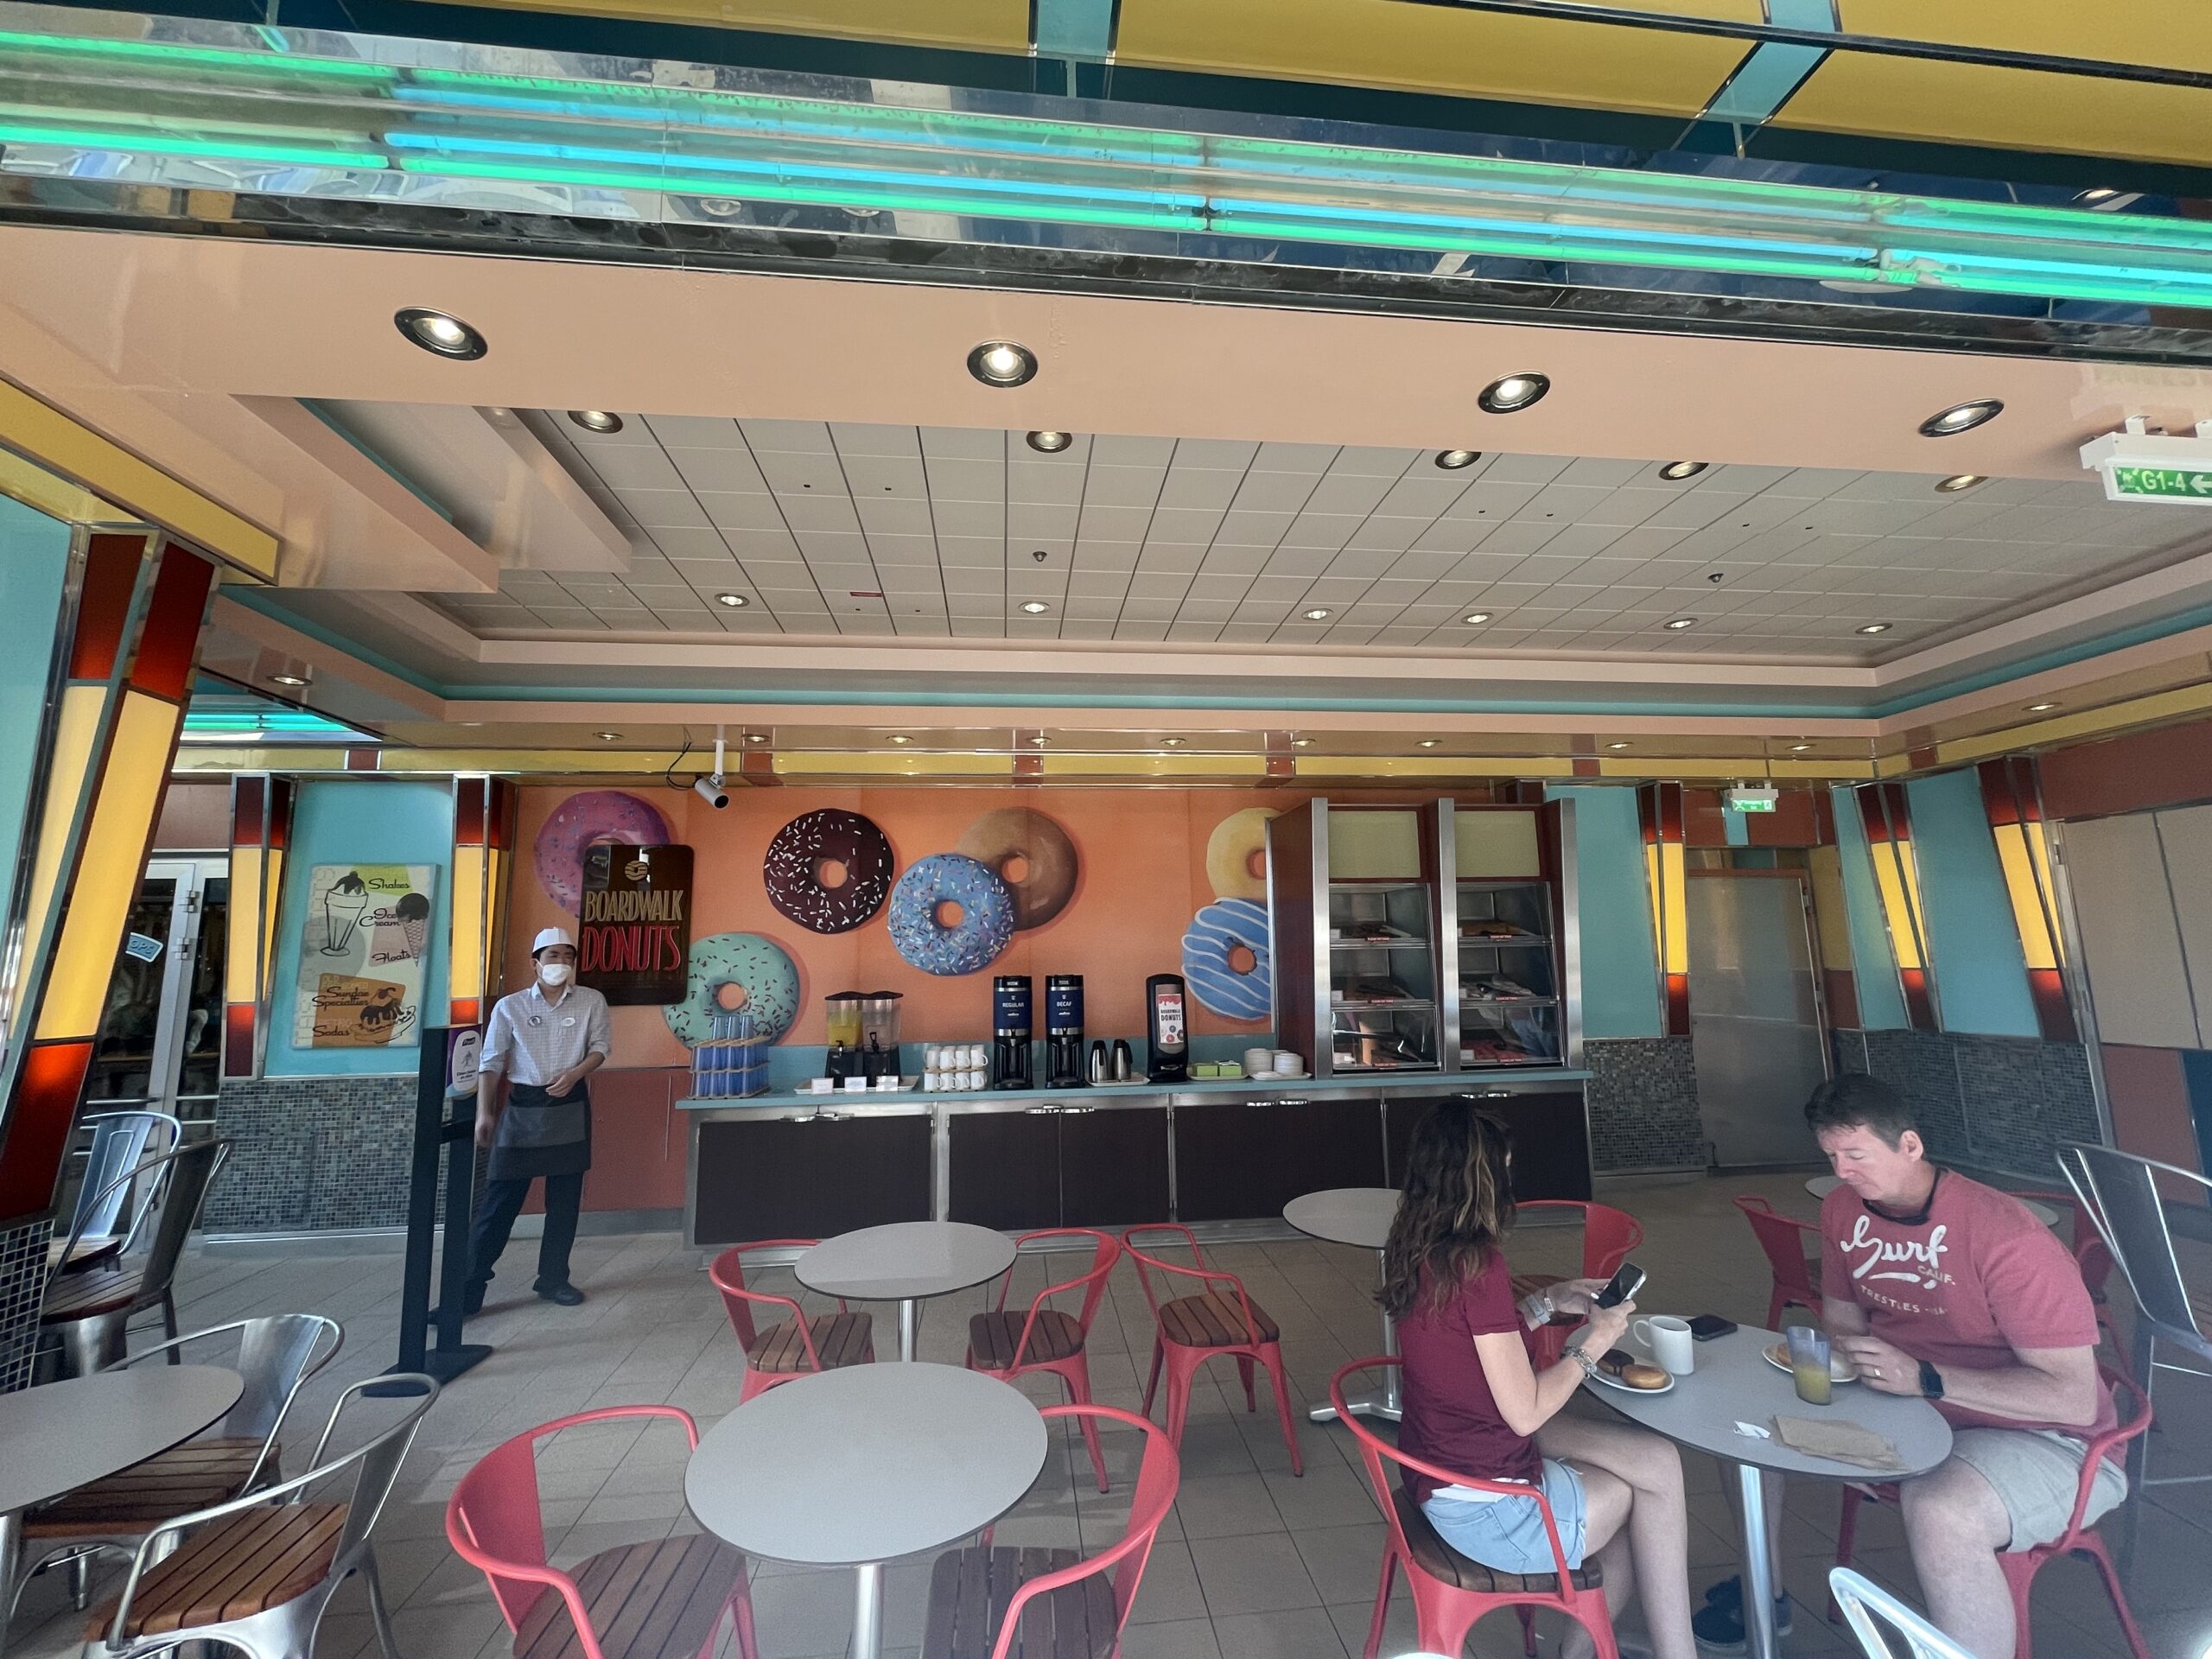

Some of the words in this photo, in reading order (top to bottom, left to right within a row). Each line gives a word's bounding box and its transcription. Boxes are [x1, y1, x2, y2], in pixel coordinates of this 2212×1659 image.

[2141, 470, 2187, 492] G1-4
[369, 878, 410, 889] Shakes
[373, 908, 397, 919] Ice
[584, 890, 684, 922] BOARDWALK
[359, 915, 401, 927] Cream
[372, 949, 411, 963] Floats
[581, 925, 682, 973] DONUTS
[312, 995, 369, 1011] Specialties
[312, 1025, 350, 1038] Sodas
[1840, 1215, 1948, 1280] Surf
[1860, 1284, 1921, 1313] TRESTLES
